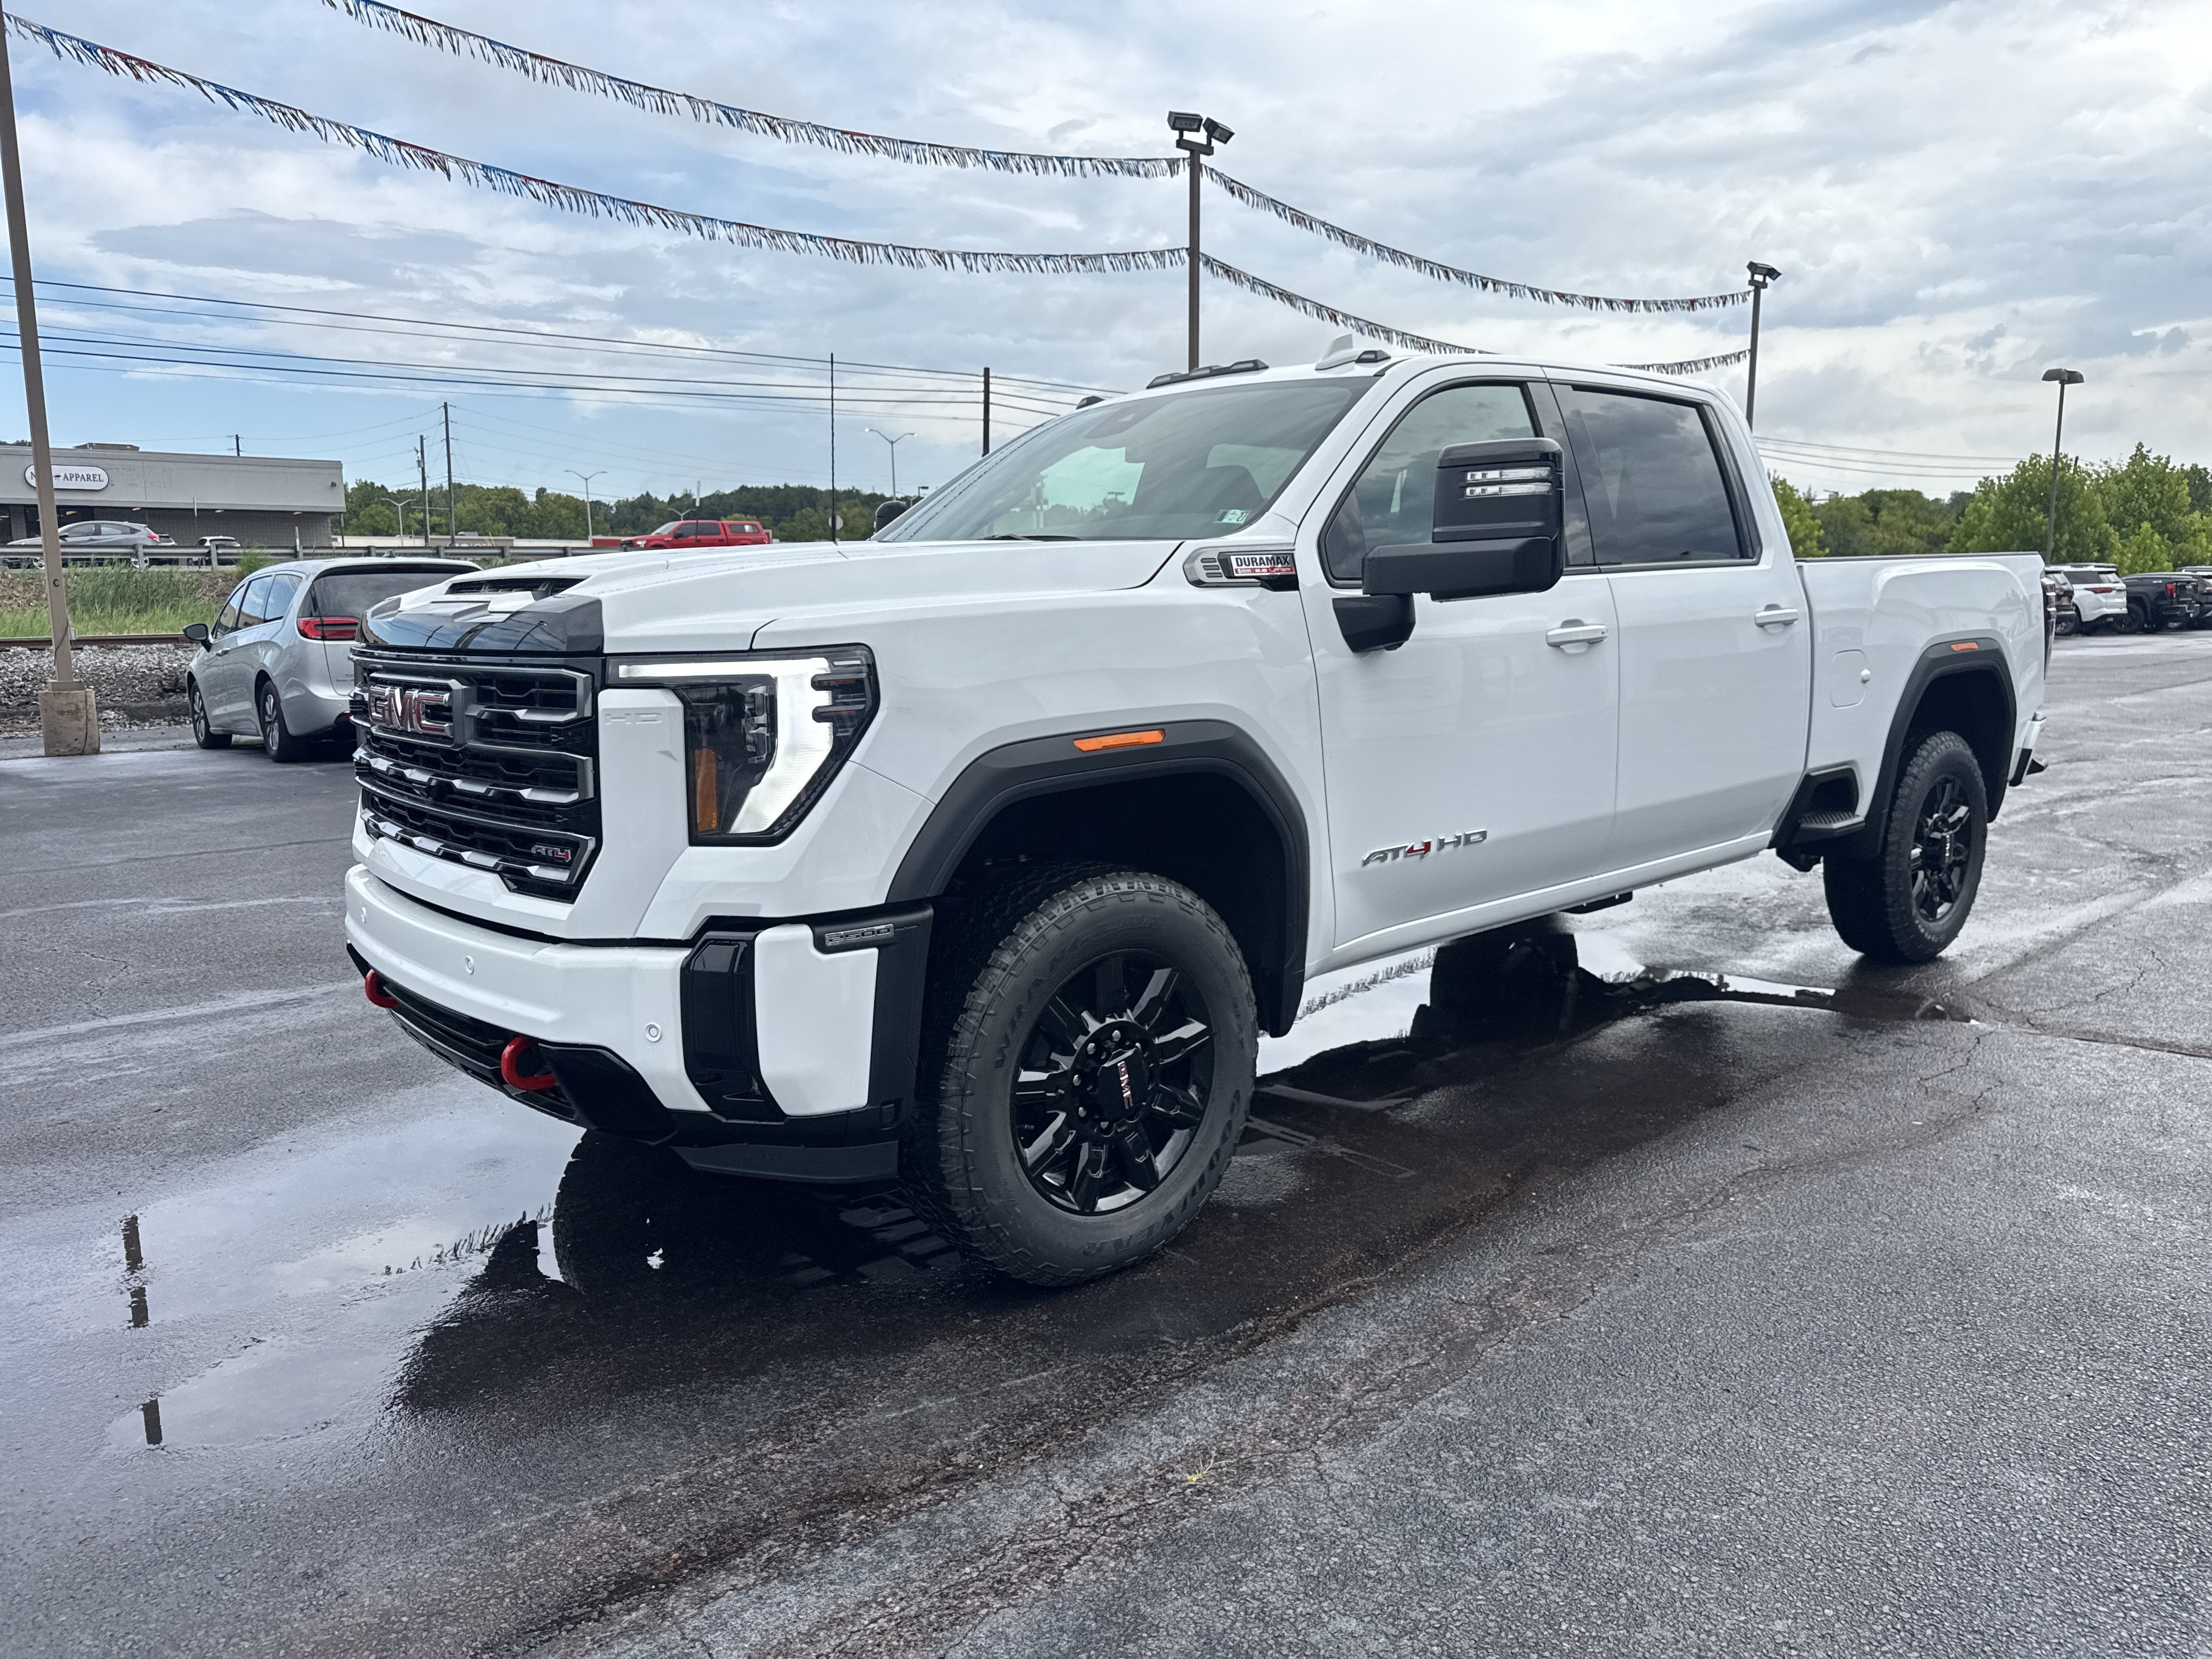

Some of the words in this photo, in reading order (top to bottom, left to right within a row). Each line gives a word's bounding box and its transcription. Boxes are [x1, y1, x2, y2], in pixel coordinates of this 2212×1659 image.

[63, 473, 104, 482] APPAREL
[1235, 556, 1290, 567] DURAMAX
[368, 684, 454, 738] GMC
[605, 713, 663, 725] HD
[531, 845, 572, 863] AT4
[1361, 838, 1432, 867] AT4
[1437, 827, 1487, 851] HD
[825, 923, 894, 947] 2500
[1117, 1060, 1133, 1109] GMC
